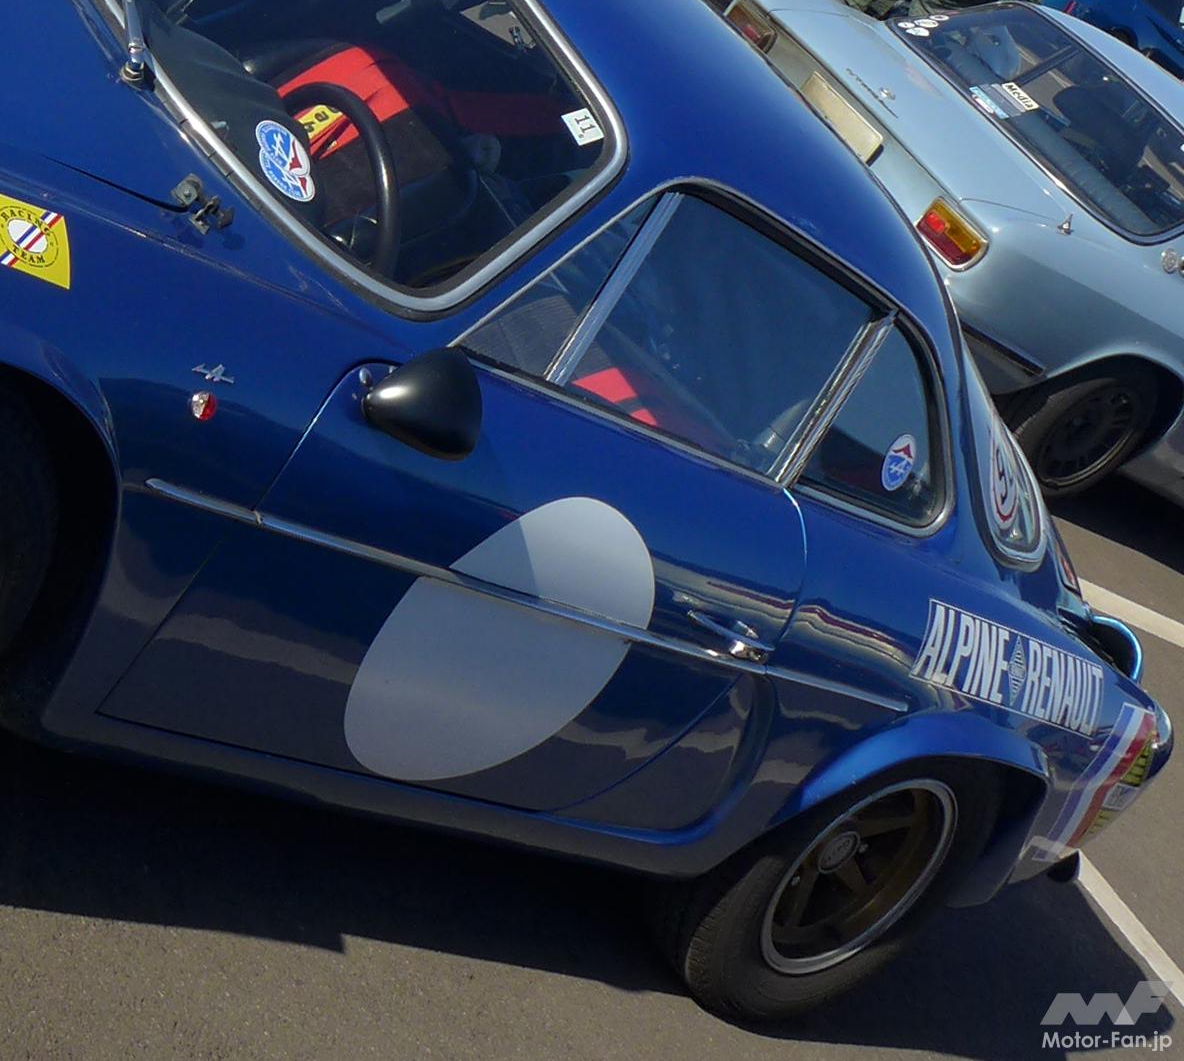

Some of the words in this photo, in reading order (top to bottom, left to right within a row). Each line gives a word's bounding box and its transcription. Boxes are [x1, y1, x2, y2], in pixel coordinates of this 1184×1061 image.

[1006, 83, 1035, 111] Media
[574, 114, 597, 134] 11
[0, 209, 51, 237] RACING
[12, 244, 46, 264] TEAM
[913, 604, 1010, 706] ALPINE
[1021, 641, 1104, 738] RENAULT
